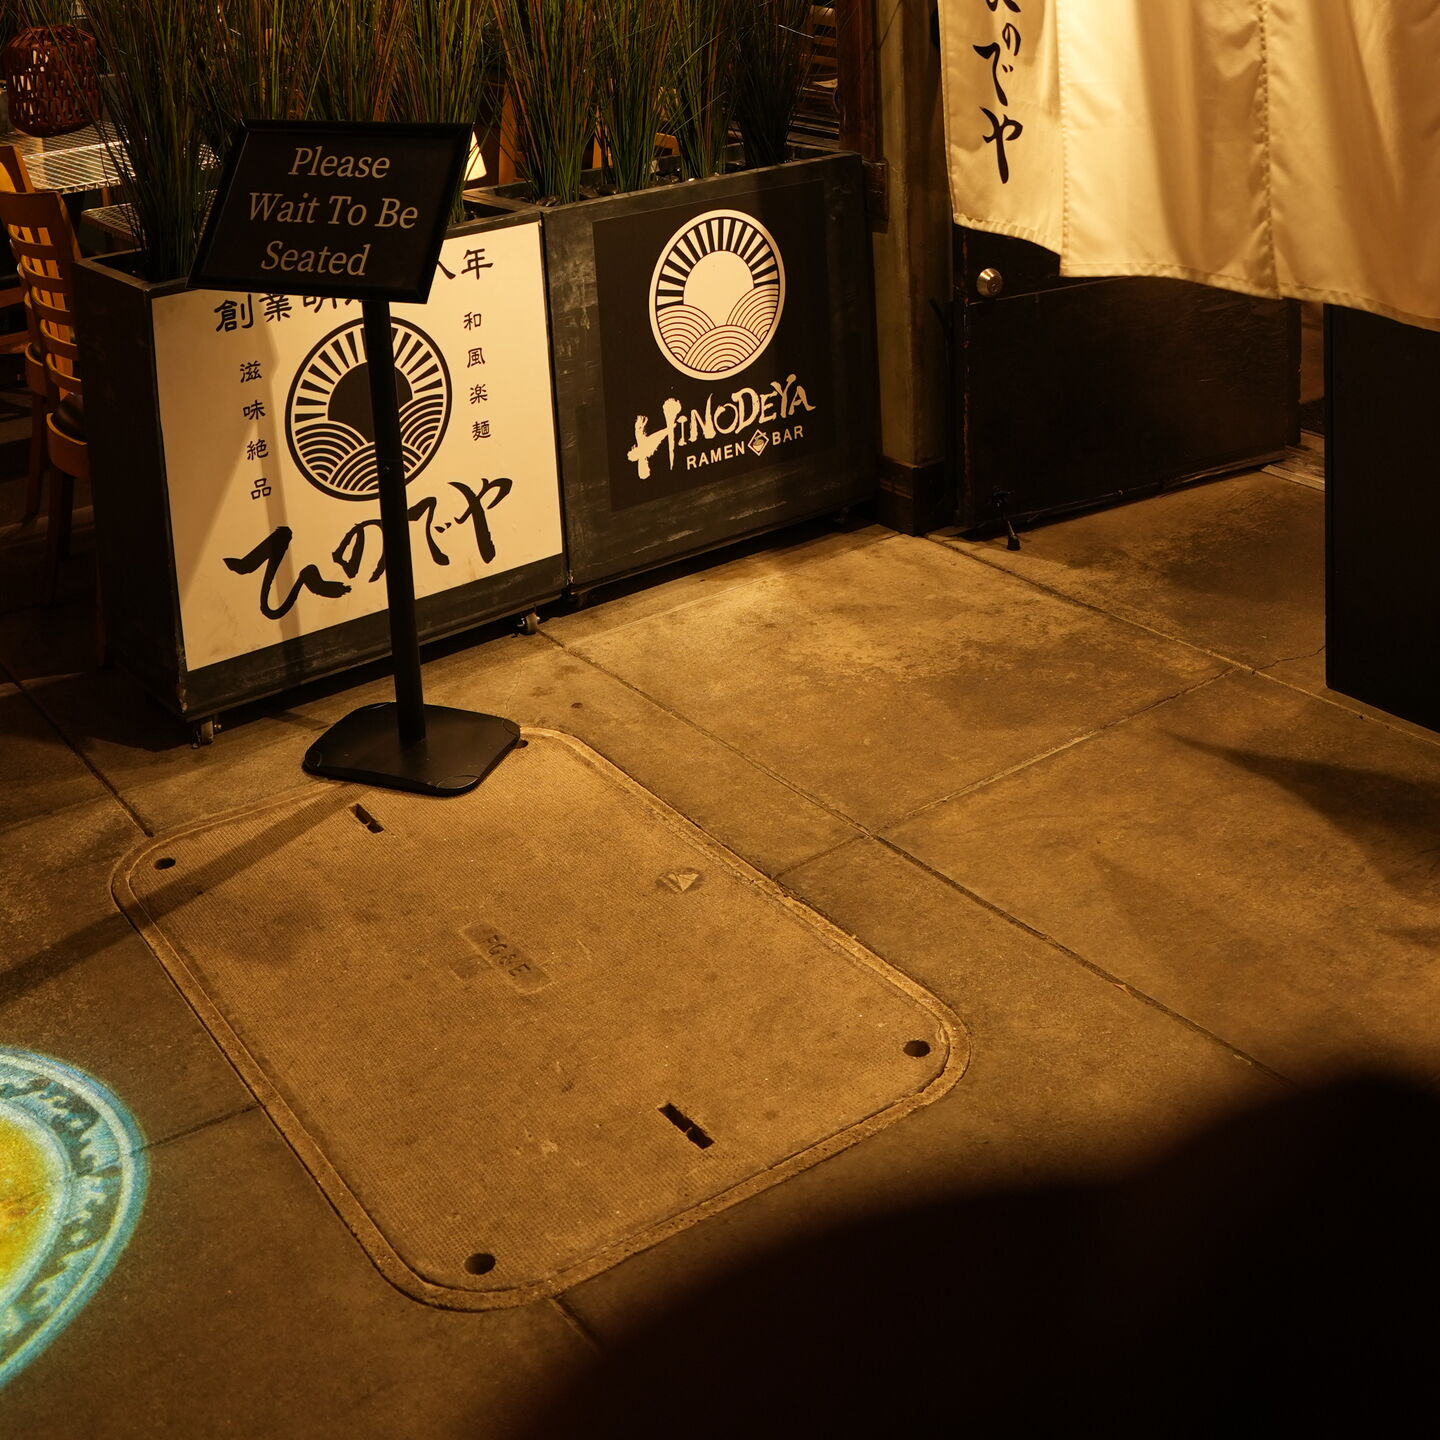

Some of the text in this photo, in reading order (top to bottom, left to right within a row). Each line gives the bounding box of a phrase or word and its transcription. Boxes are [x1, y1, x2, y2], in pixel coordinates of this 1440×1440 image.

[288, 146, 390, 179] Please
[249, 192, 418, 229] Wait To Be
[261, 240, 371, 276] Seated
[462, 311, 492, 441] 和風楽麺
[239, 361, 273, 501] 滋味絶品
[627, 373, 816, 480] HINODEYA
[686, 425, 804, 471] RAMEN BAR
[222, 477, 513, 621] ひのでや
